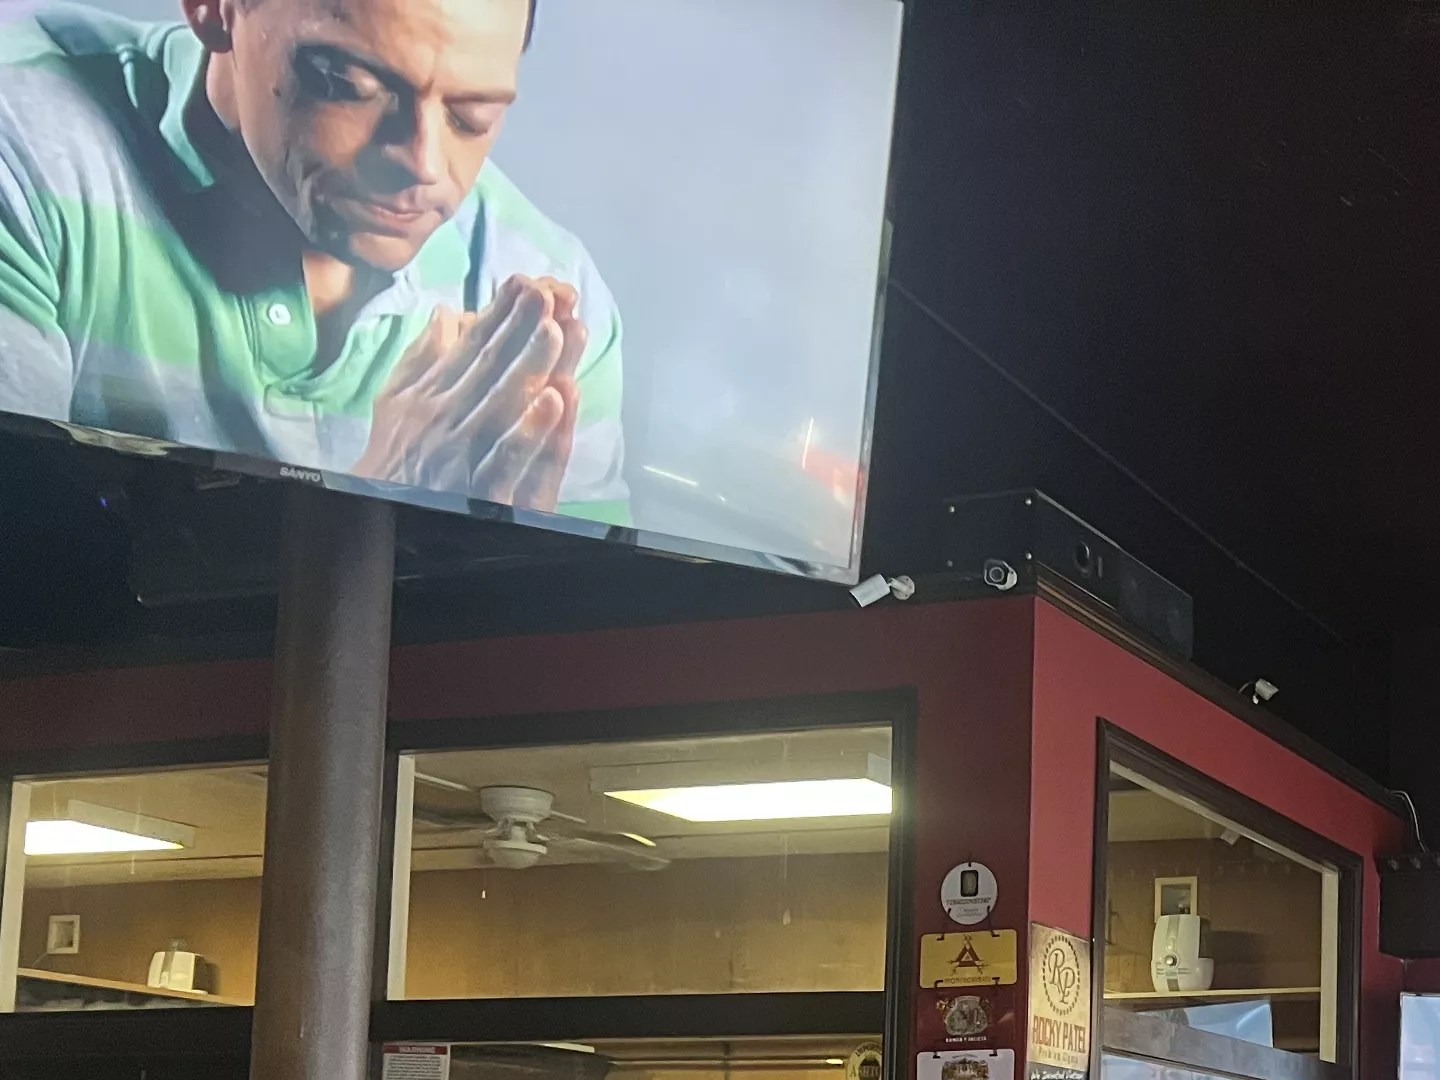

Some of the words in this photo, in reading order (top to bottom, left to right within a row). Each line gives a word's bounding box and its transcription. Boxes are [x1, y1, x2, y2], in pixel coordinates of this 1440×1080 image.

[279, 466, 321, 482] SANYO
[1032, 1013, 1062, 1048] ROCKY
[1062, 1021, 1087, 1054] PATEL
